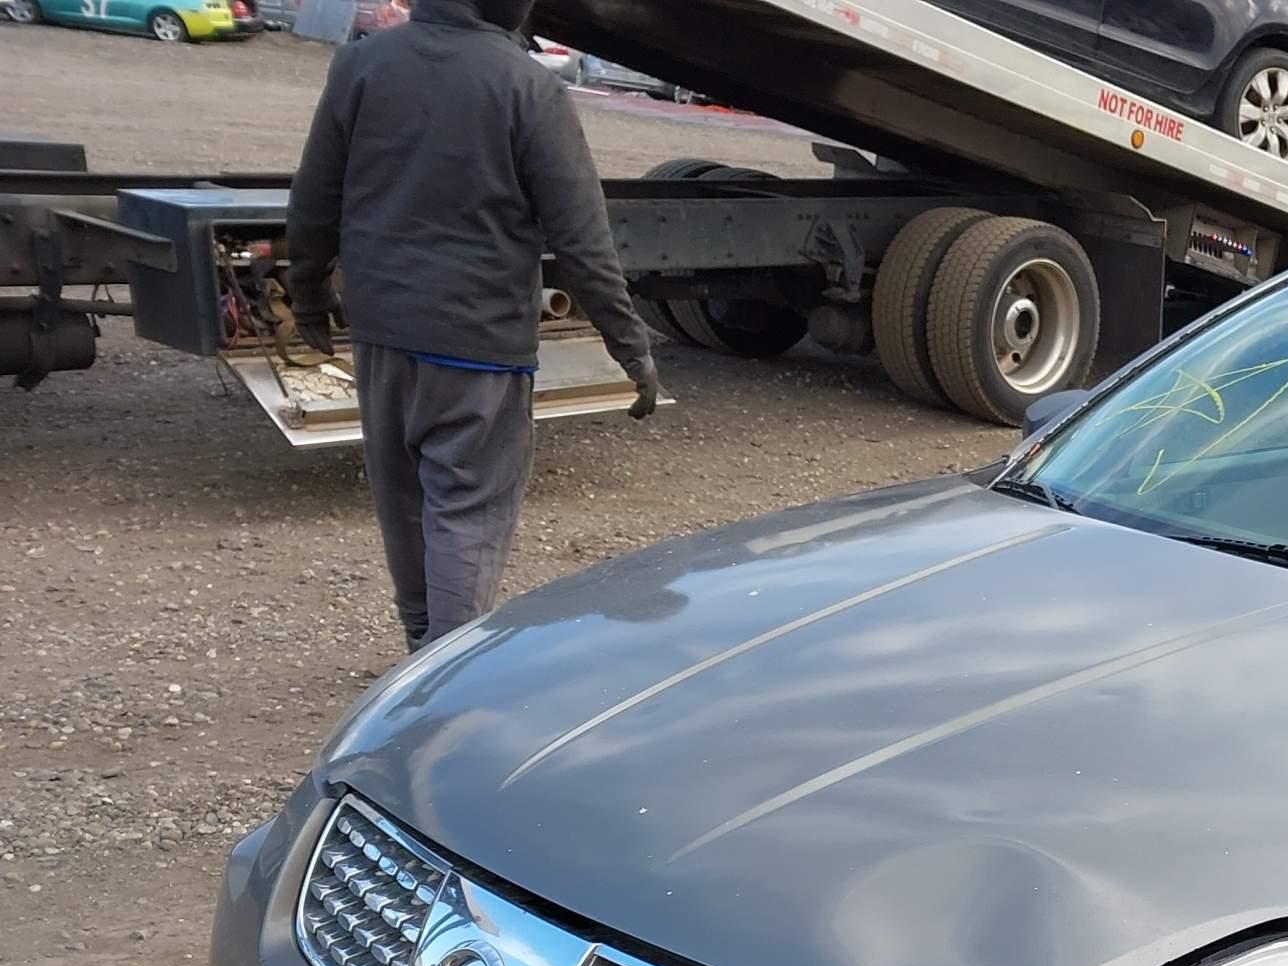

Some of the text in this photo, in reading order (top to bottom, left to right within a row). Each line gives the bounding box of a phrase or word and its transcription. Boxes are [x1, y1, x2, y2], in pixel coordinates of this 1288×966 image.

[1098, 89, 1184, 142] NOT FOR HIRE
